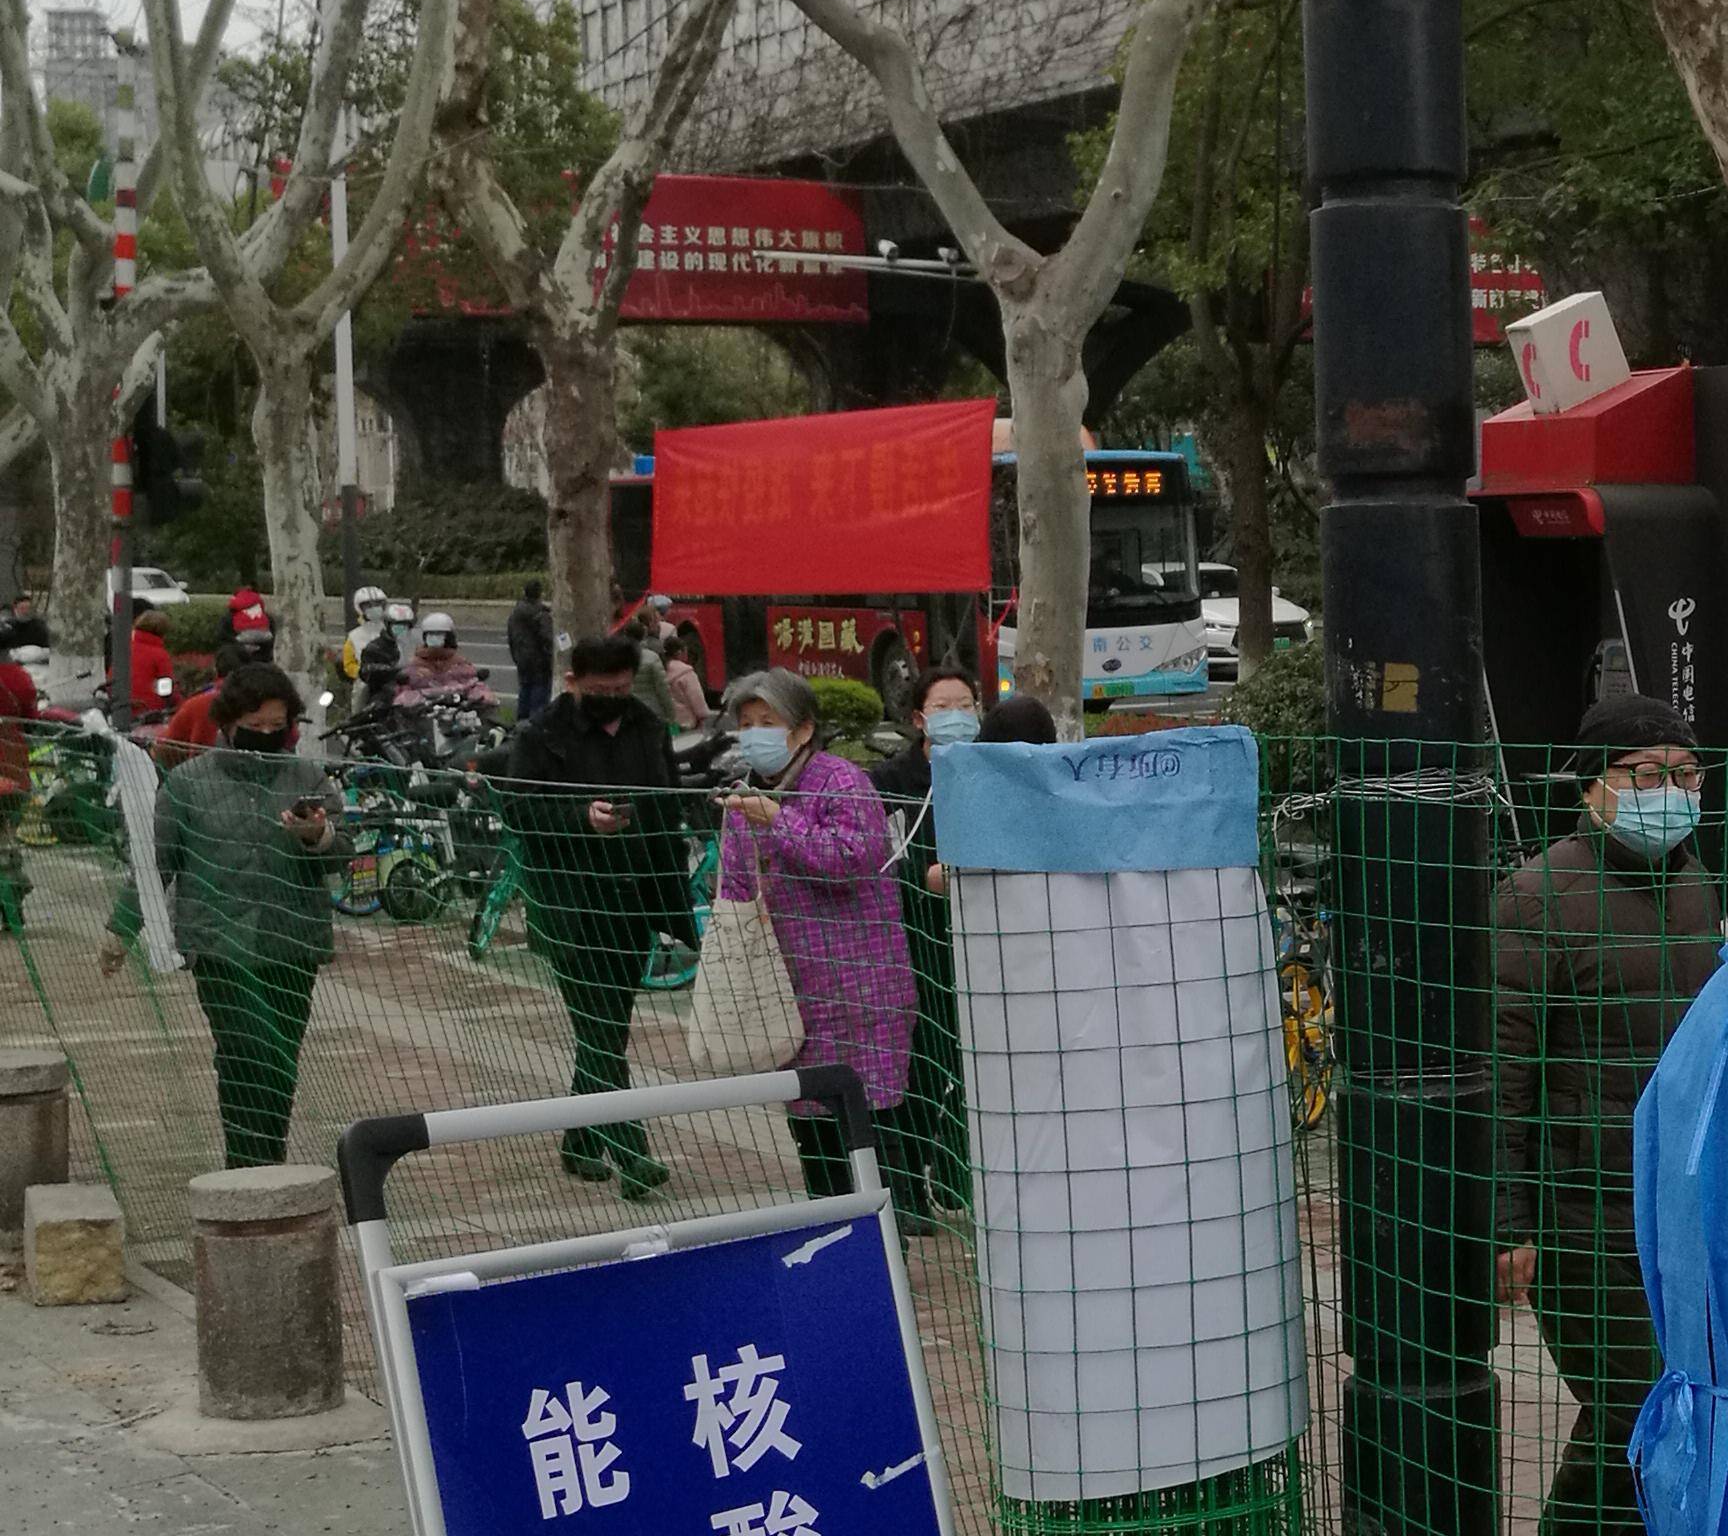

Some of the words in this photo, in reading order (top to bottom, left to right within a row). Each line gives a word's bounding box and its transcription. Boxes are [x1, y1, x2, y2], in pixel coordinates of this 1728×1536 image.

[1671, 642, 1679, 674] CHINA
[1681, 642, 1695, 722] 中国电信
